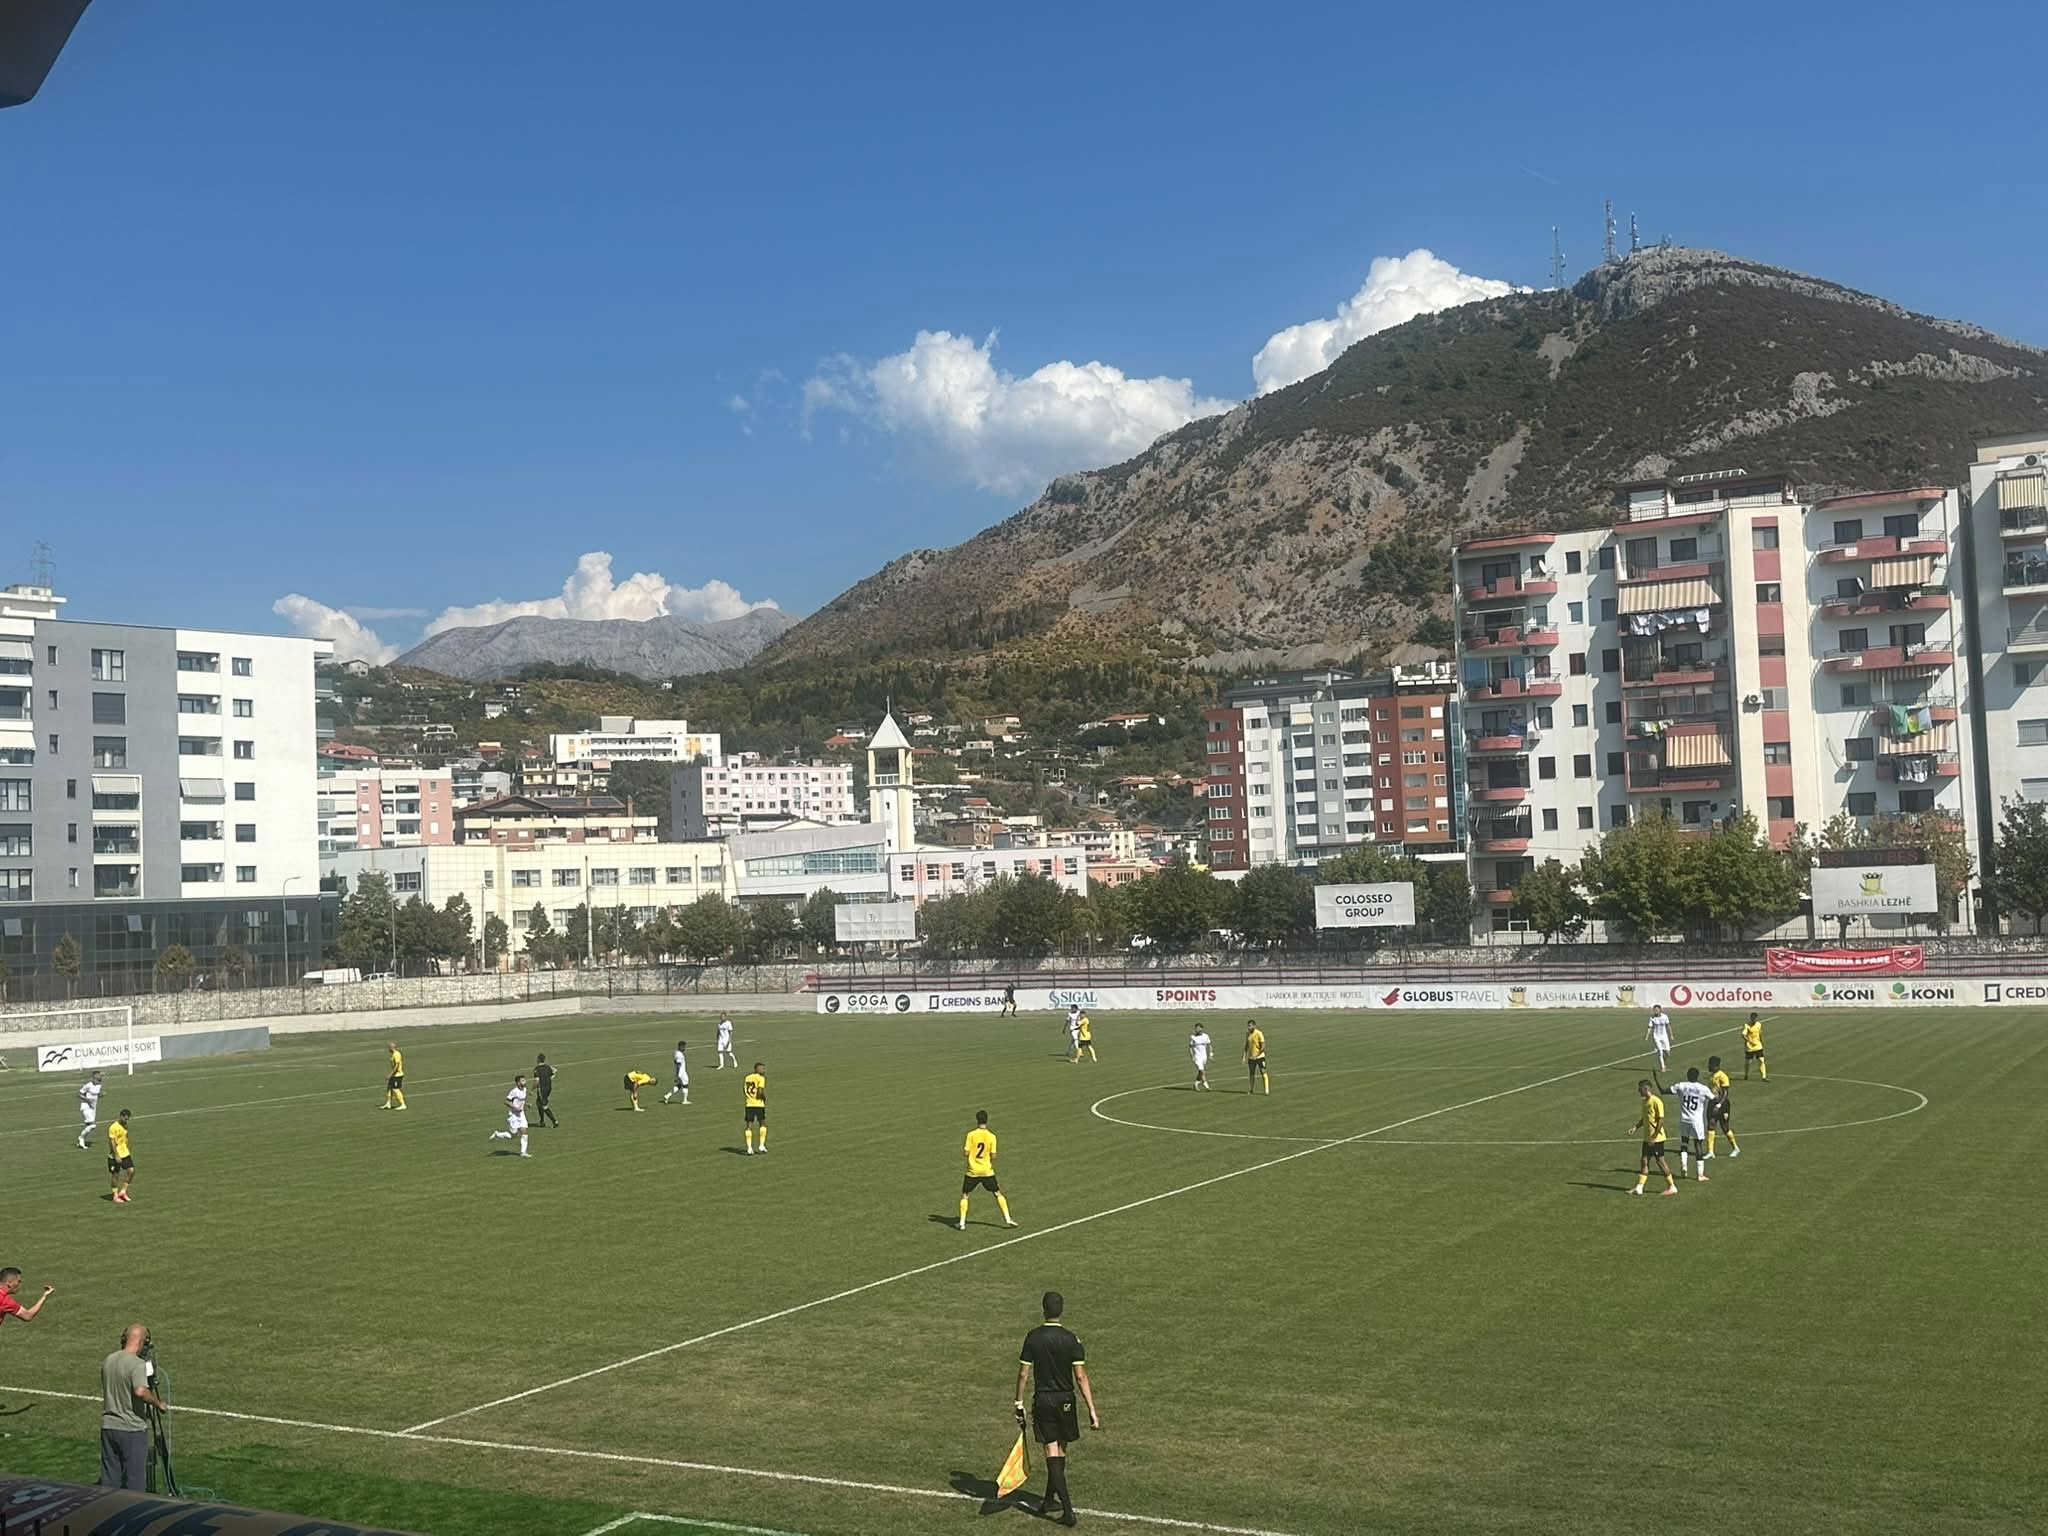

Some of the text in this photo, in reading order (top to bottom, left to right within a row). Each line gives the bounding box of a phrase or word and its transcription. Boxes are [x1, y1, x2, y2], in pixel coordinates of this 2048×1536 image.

[1335, 893, 1393, 905] COLOSSEO
[1838, 898, 1879, 908] BASHKIA
[1345, 907, 1384, 917] GROUP
[1060, 991, 1097, 1003] SIGAL
[1156, 989, 1217, 1002] 5POINTS
[1536, 992, 1577, 1001] BASHKIA
[1695, 987, 1773, 1001] vodafone
[1833, 990, 1875, 1000] KONI
[1911, 989, 1954, 999] KONI
[2005, 987, 2048, 998] CRED
[848, 994, 888, 1006] GOGA
[942, 996, 1004, 1006] CREDINS BAN
[74, 1041, 157, 1057] DUKAGJINI RSORT
[1683, 1095, 1699, 1111] 45
[975, 1142, 985, 1159] 2
